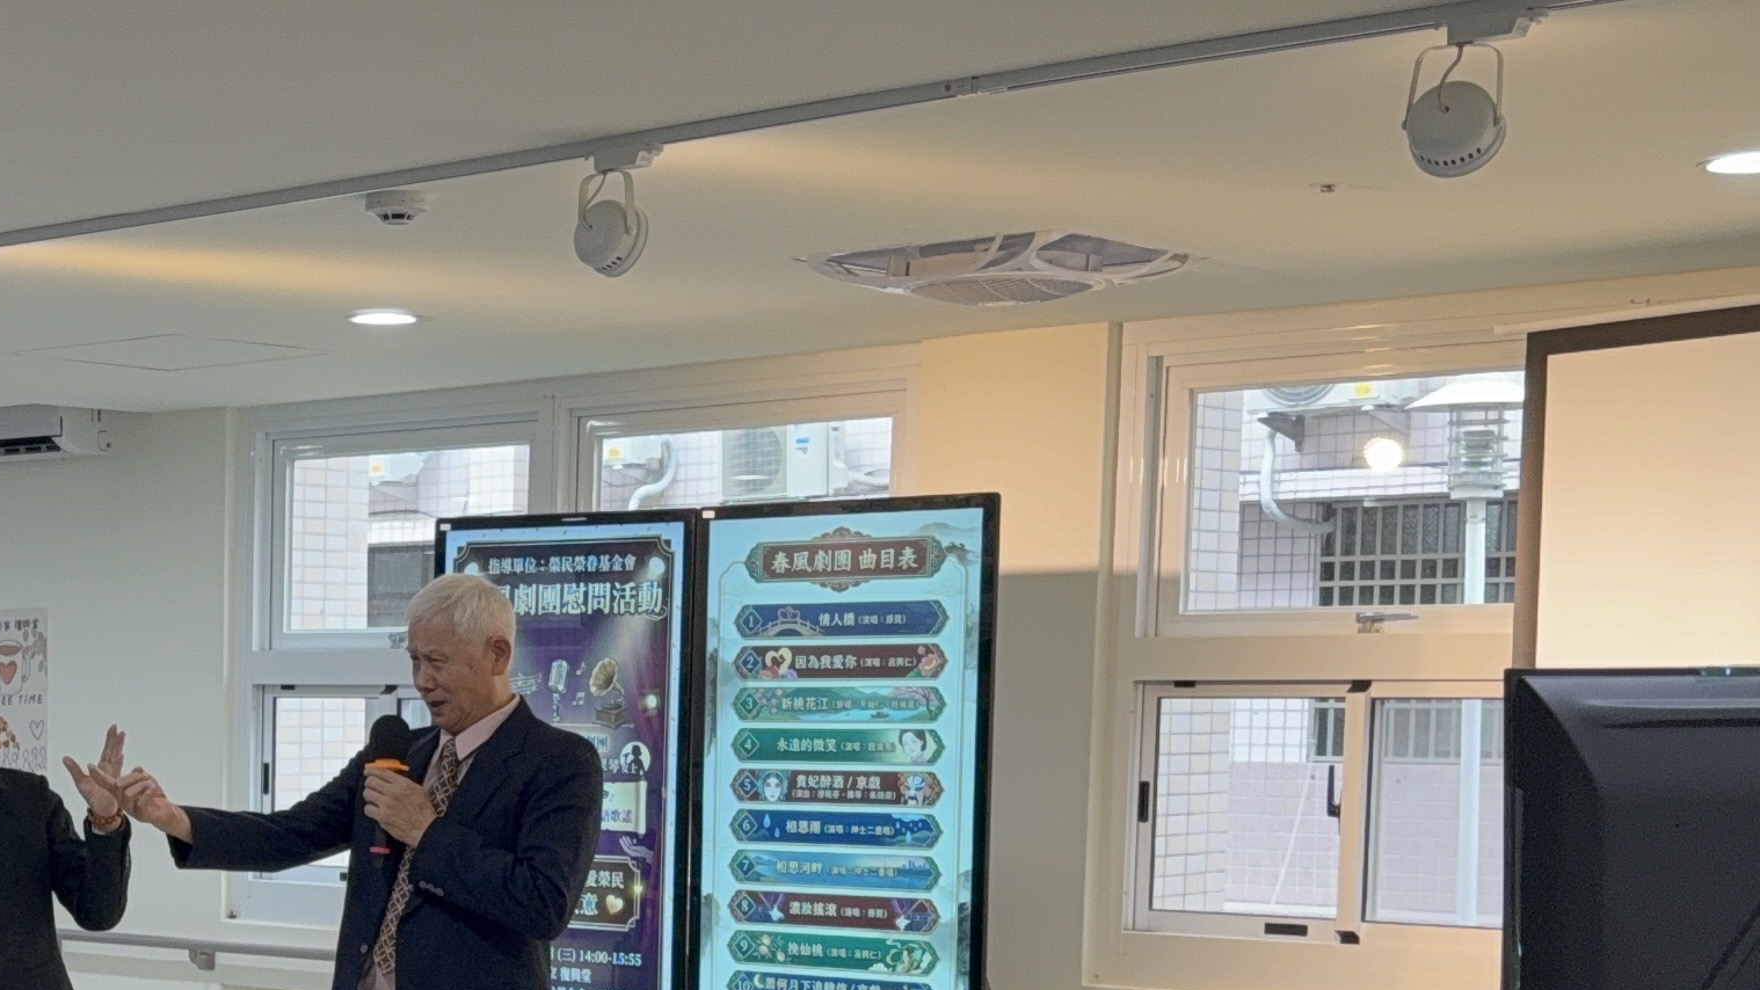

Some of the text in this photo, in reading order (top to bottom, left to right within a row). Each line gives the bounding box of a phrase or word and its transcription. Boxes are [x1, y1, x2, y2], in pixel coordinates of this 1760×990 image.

[771, 548, 919, 574] 春風劇團 曲目表
[748, 614, 755, 627] 1
[746, 657, 755, 669] 2
[795, 654, 857, 670] 因為我愛你
[19, 694, 43, 704] TIME
[746, 698, 753, 710] 3
[744, 739, 752, 750] 4
[743, 779, 752, 791] 5
[742, 819, 750, 831] 6
[742, 860, 750, 871] 7
[741, 899, 749, 912] 8
[740, 939, 748, 952] 9
